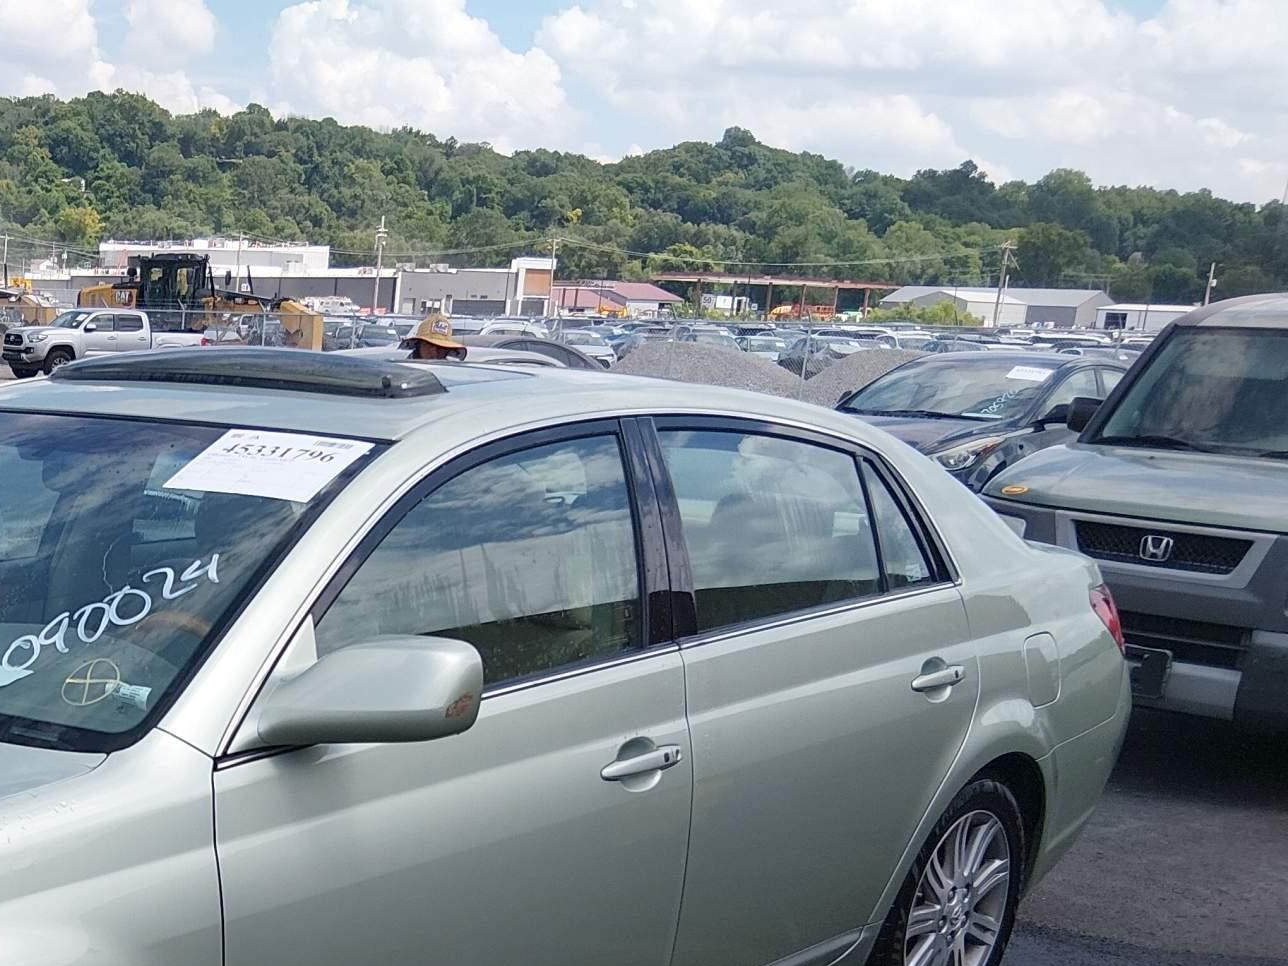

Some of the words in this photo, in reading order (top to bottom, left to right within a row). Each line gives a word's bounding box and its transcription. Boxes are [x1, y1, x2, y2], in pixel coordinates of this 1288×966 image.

[115, 291, 130, 304] CAT
[222, 443, 336, 463] 45331796
[1, 553, 220, 672] 090024
